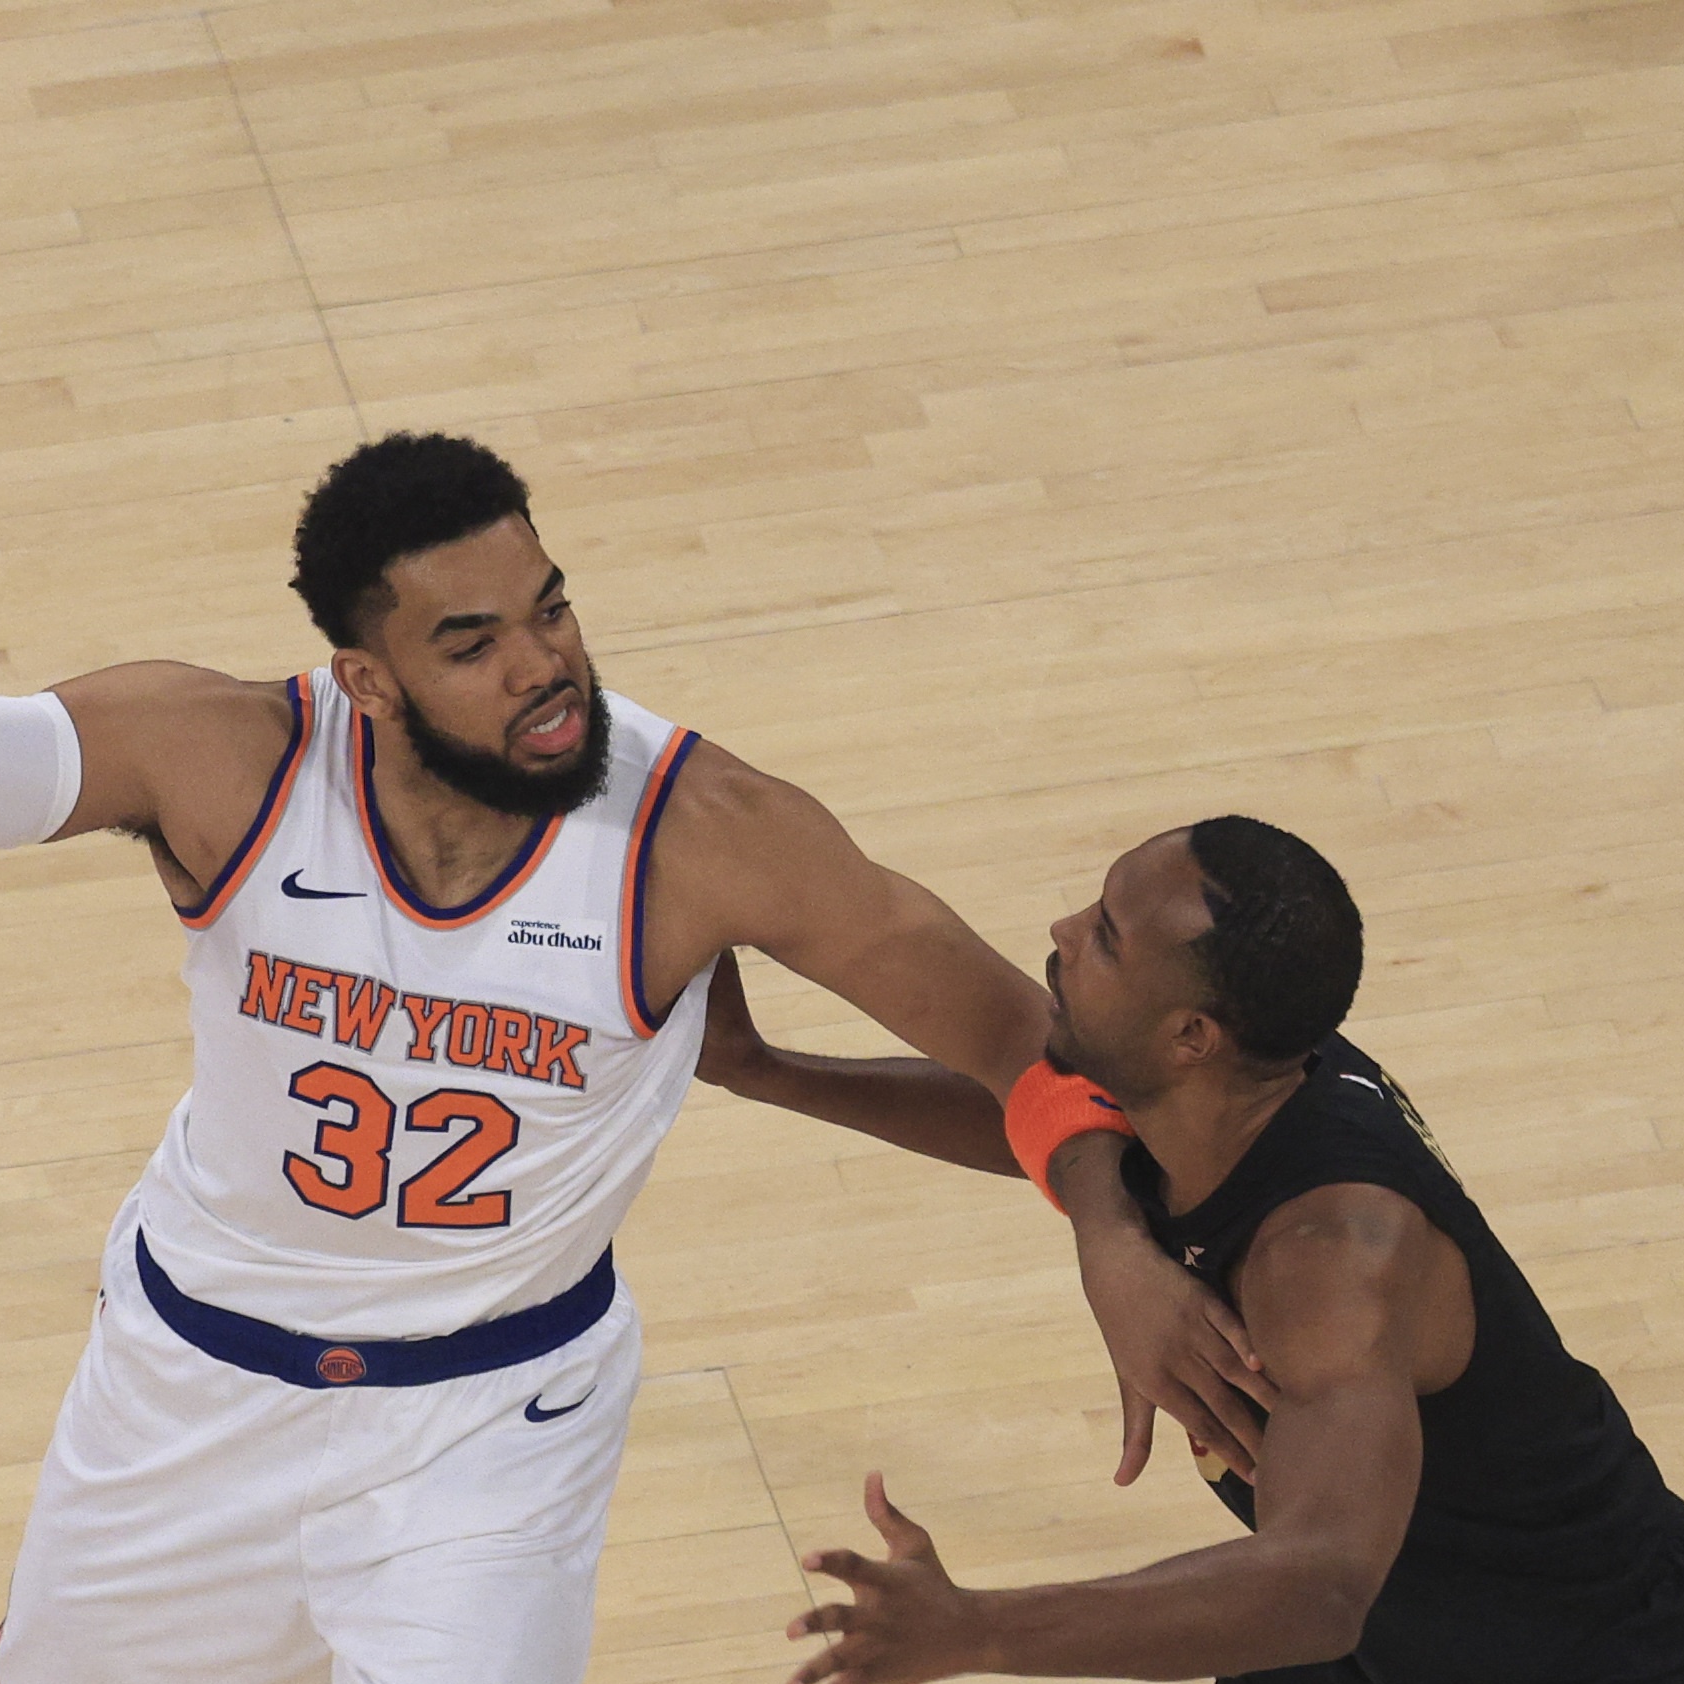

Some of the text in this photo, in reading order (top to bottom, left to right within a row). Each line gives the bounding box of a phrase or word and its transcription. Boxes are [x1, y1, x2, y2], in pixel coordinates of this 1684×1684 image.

[507, 929, 604, 951] abu dhabi
[510, 919, 561, 930] experience
[238, 950, 592, 1091] NEW YORK
[282, 1060, 521, 1229] 32
